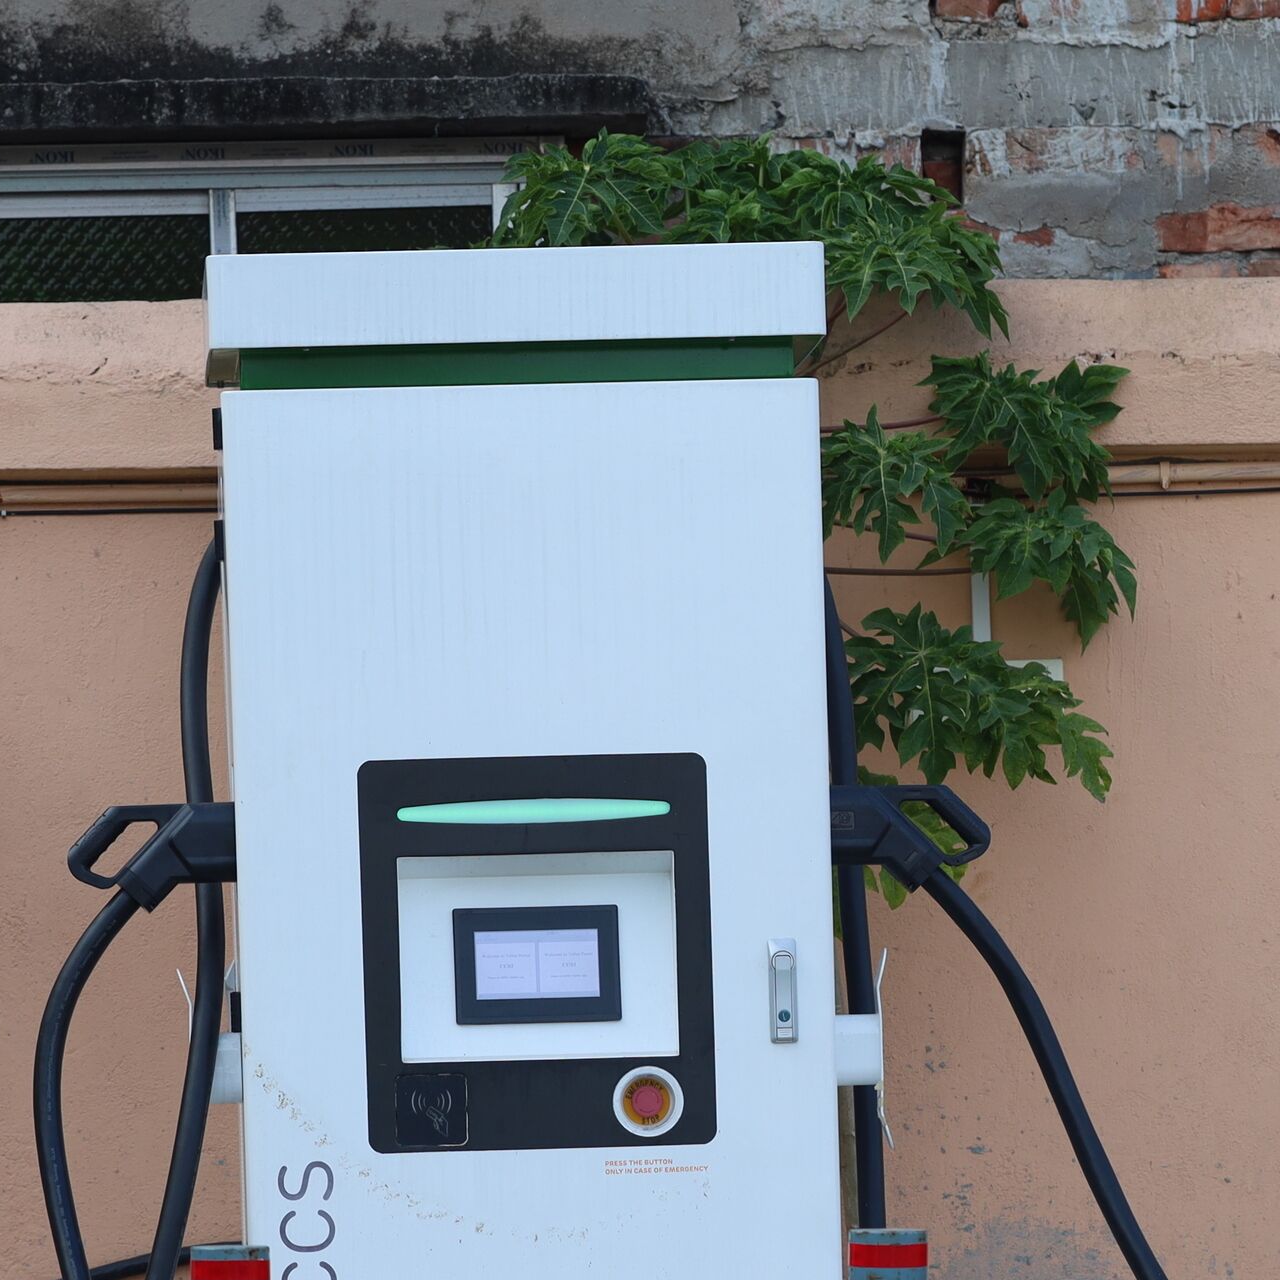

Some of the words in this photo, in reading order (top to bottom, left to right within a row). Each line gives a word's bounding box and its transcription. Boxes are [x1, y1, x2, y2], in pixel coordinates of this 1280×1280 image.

[185, 148, 226, 160] IKON
[334, 145, 375, 157] IKON
[34, 151, 74, 164] IKON
[626, 1080, 664, 1100] EMERGENCY
[641, 1114, 661, 1125] STOP
[644, 1158, 673, 1166] BUTTON
[653, 1166, 663, 1174] OF
[664, 1165, 709, 1174] EMERGENCY
